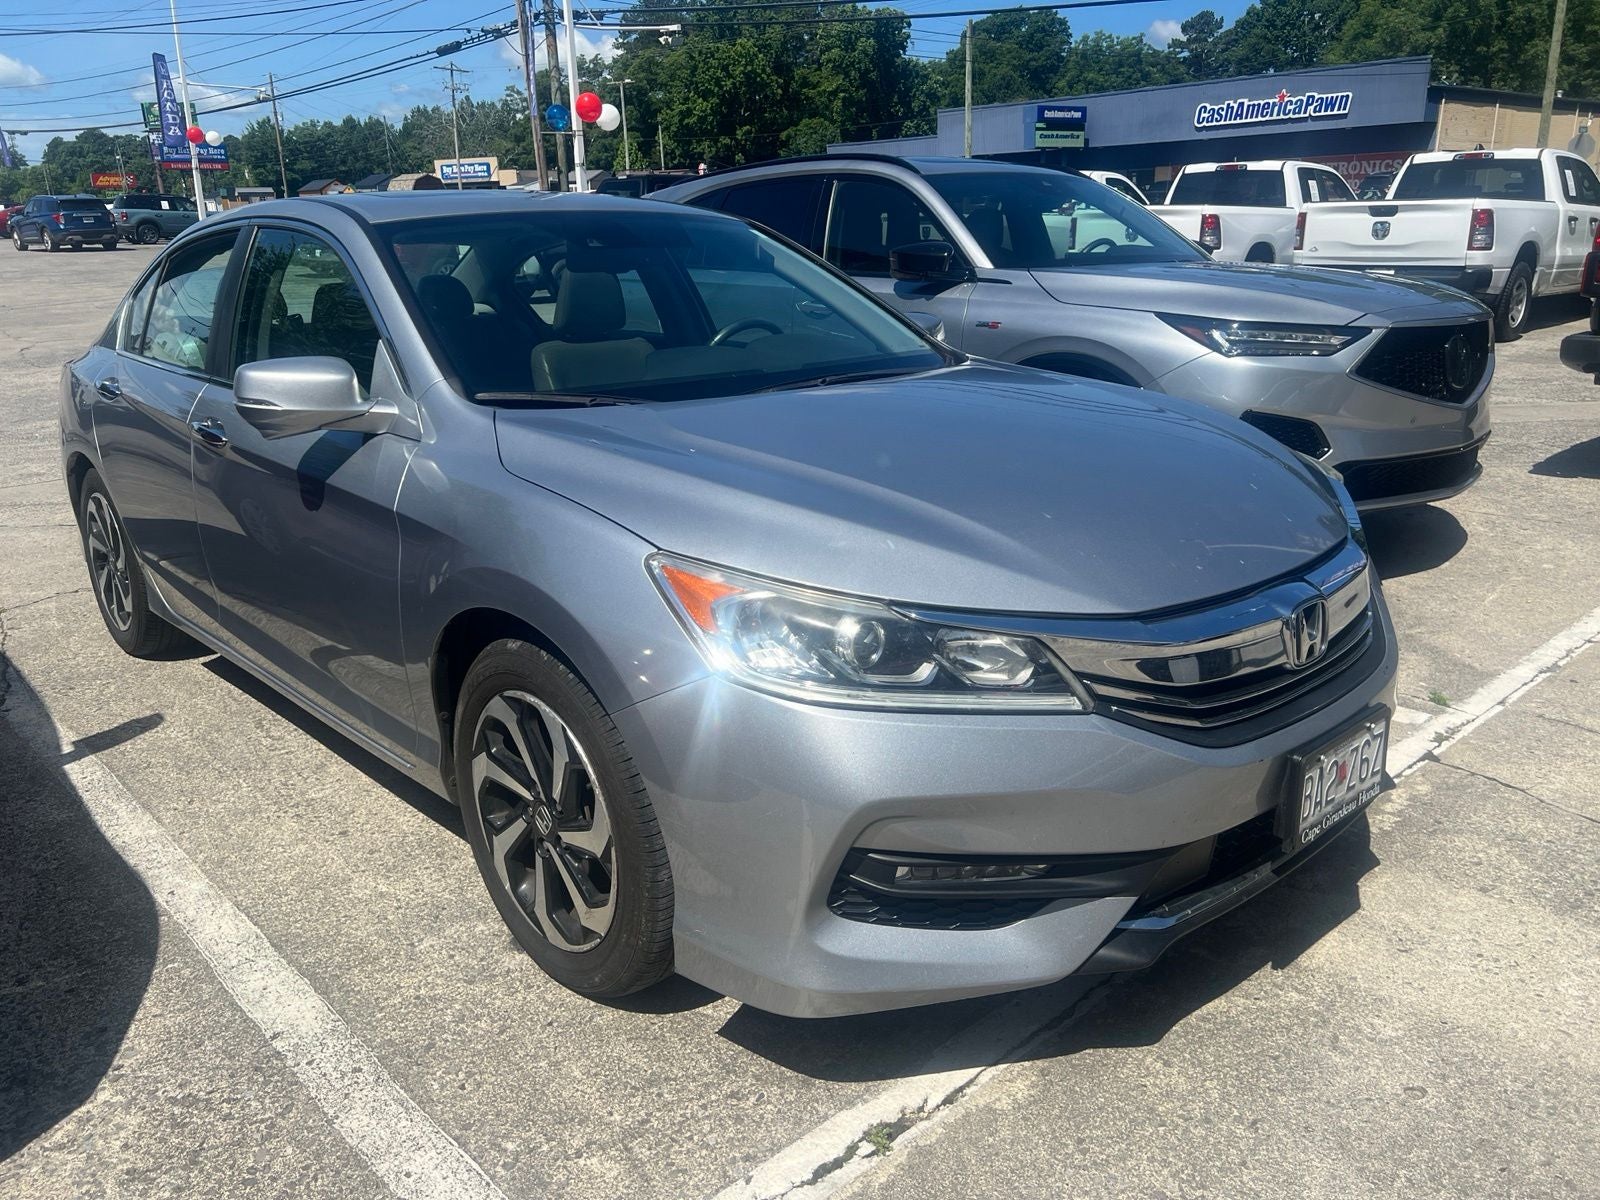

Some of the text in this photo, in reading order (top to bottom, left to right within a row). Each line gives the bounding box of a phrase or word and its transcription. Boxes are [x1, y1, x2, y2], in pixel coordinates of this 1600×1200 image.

[161, 79, 182, 136] HONDA
[163, 146, 177, 155] Buy
[178, 146, 191, 154] Her
[196, 147, 208, 155] Pay
[1322, 159, 1403, 175] TRONICS
[1301, 783, 1380, 844] Cape Girardeau Honda
